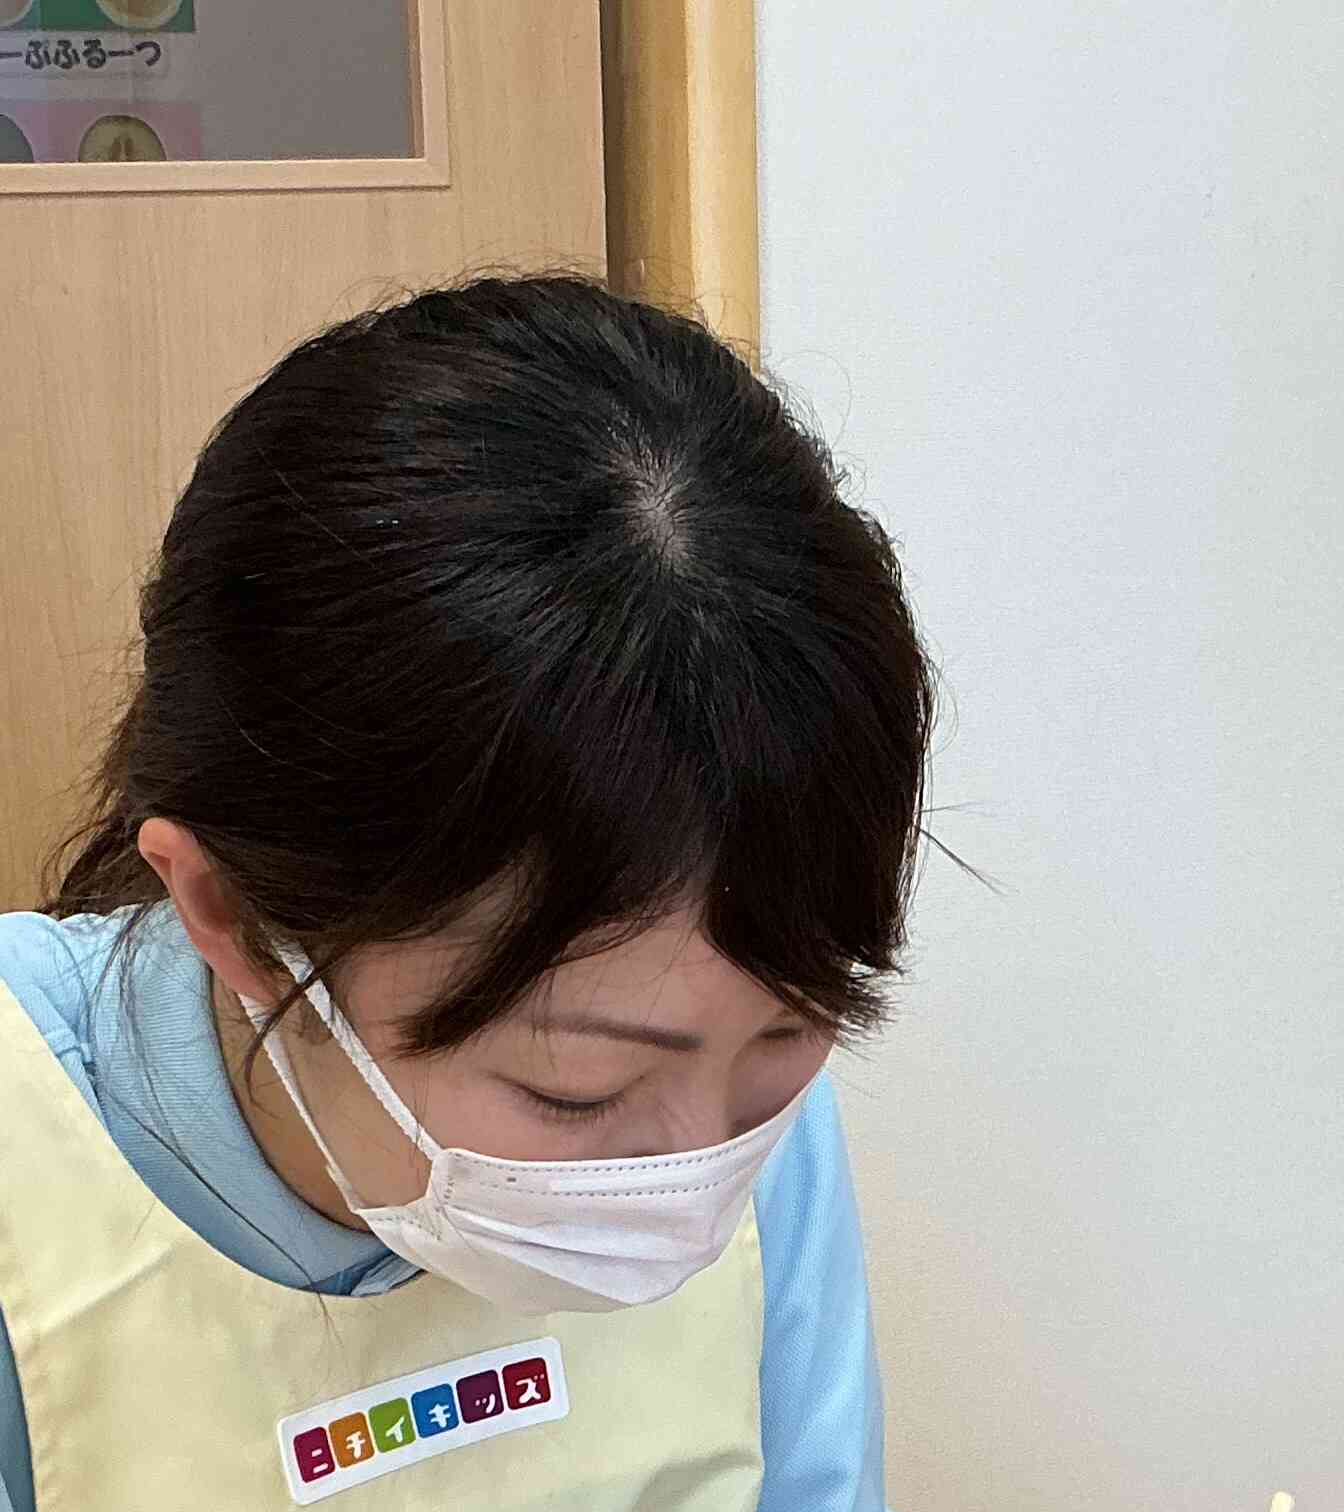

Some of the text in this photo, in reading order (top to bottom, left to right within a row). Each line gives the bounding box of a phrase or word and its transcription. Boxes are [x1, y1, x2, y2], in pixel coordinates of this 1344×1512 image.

[310, 1373, 546, 1475] ニチイキッズ
